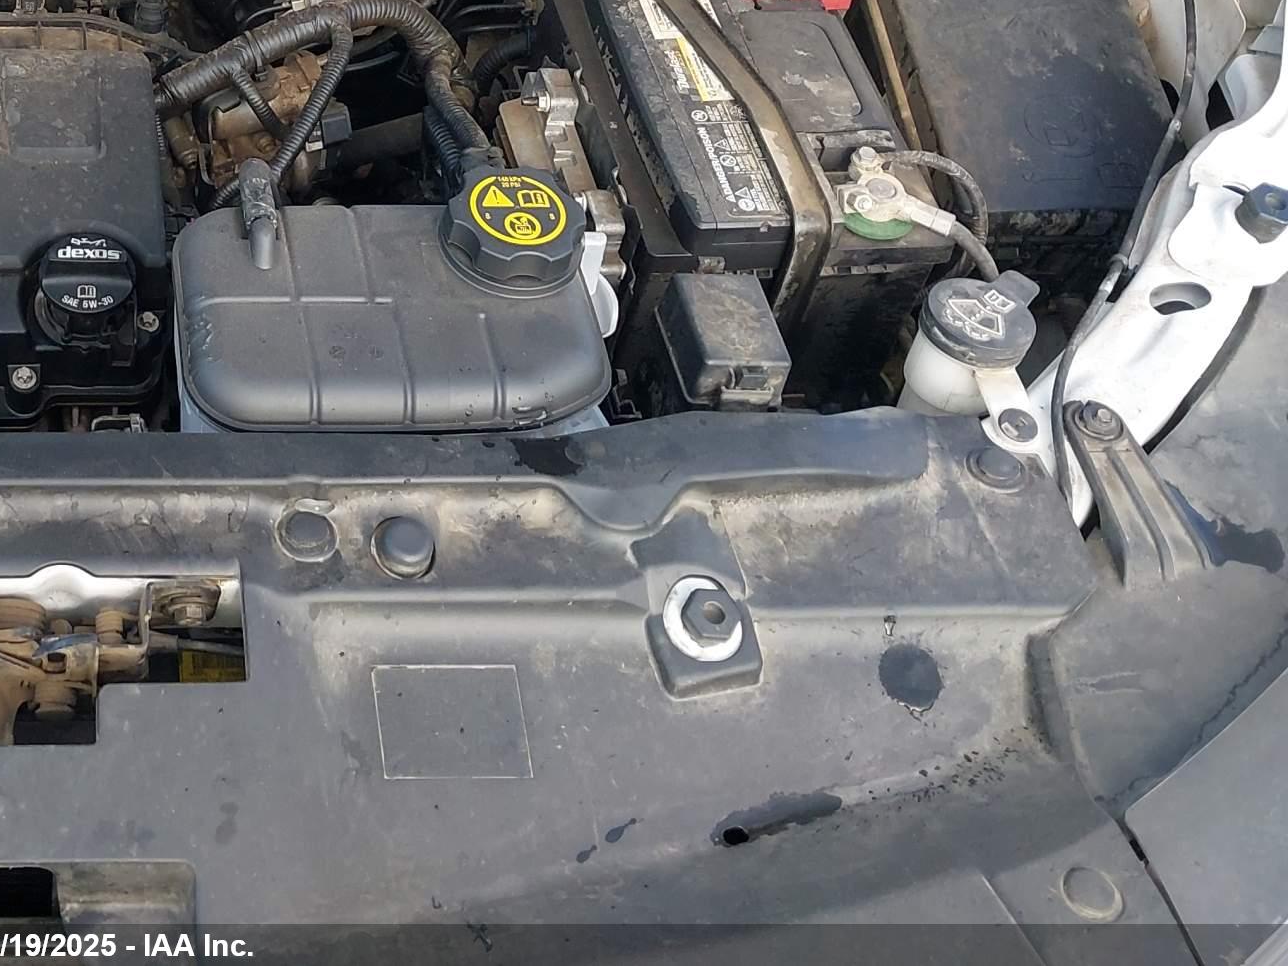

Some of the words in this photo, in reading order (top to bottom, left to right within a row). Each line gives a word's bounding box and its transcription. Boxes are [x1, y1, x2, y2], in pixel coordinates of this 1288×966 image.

[697, 127, 734, 197] DANGER/POISON
[57, 245, 123, 260] dexos
[61, 294, 80, 308] SAE
[82, 295, 114, 309] 5W-30
